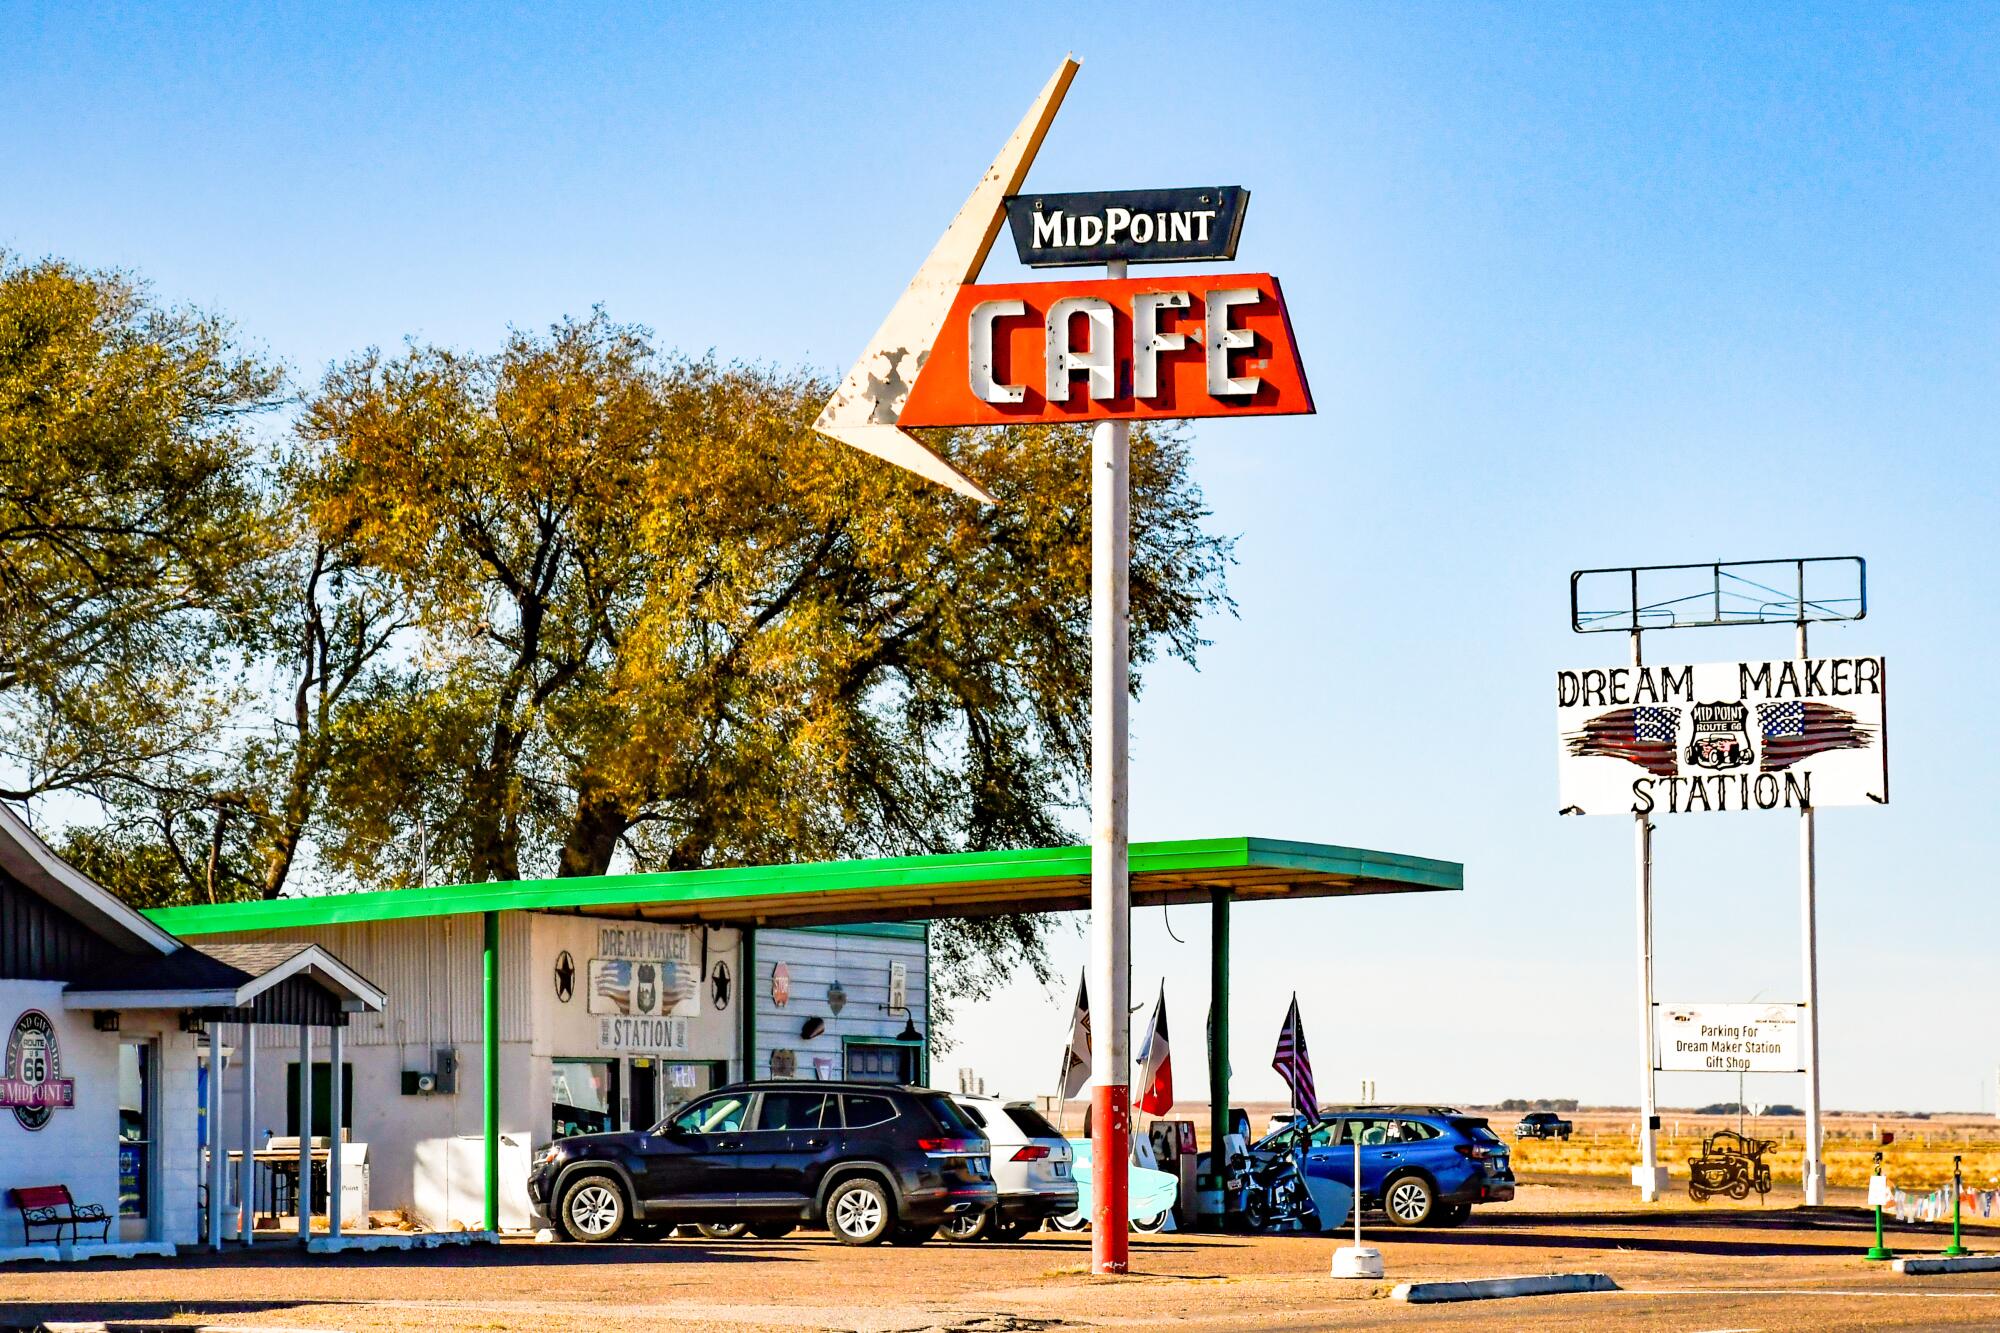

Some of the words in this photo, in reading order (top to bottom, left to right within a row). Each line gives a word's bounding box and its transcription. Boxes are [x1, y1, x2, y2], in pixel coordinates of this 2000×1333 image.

[969, 288, 1260, 402] CAFE
[1558, 665, 1693, 707] DREAM
[1739, 657, 1880, 699] MAKER
[1694, 706, 1713, 721] MID
[1714, 706, 1744, 721] POINT
[1696, 723, 1728, 731] ROUTE
[1731, 722, 1742, 731] 66
[1631, 771, 1812, 814] STATION
[602, 928, 643, 957] DREAM
[647, 931, 687, 959] MAKER
[774, 976, 789, 993] STOP
[614, 1019, 672, 1047] STATION
[1701, 1025, 1739, 1039] Parking
[1743, 1025, 1758, 1037] For
[23, 1039, 44, 1047] ROUTE
[1676, 1040, 1708, 1052] Dream
[1711, 1041, 1742, 1052] Maker
[1745, 1041, 1781, 1053] Station
[23, 1058, 44, 1082] 66
[1706, 1056, 1723, 1068] Gift
[1726, 1056, 1750, 1069] Shop
[7, 1083, 61, 1103] MIDPOINT
